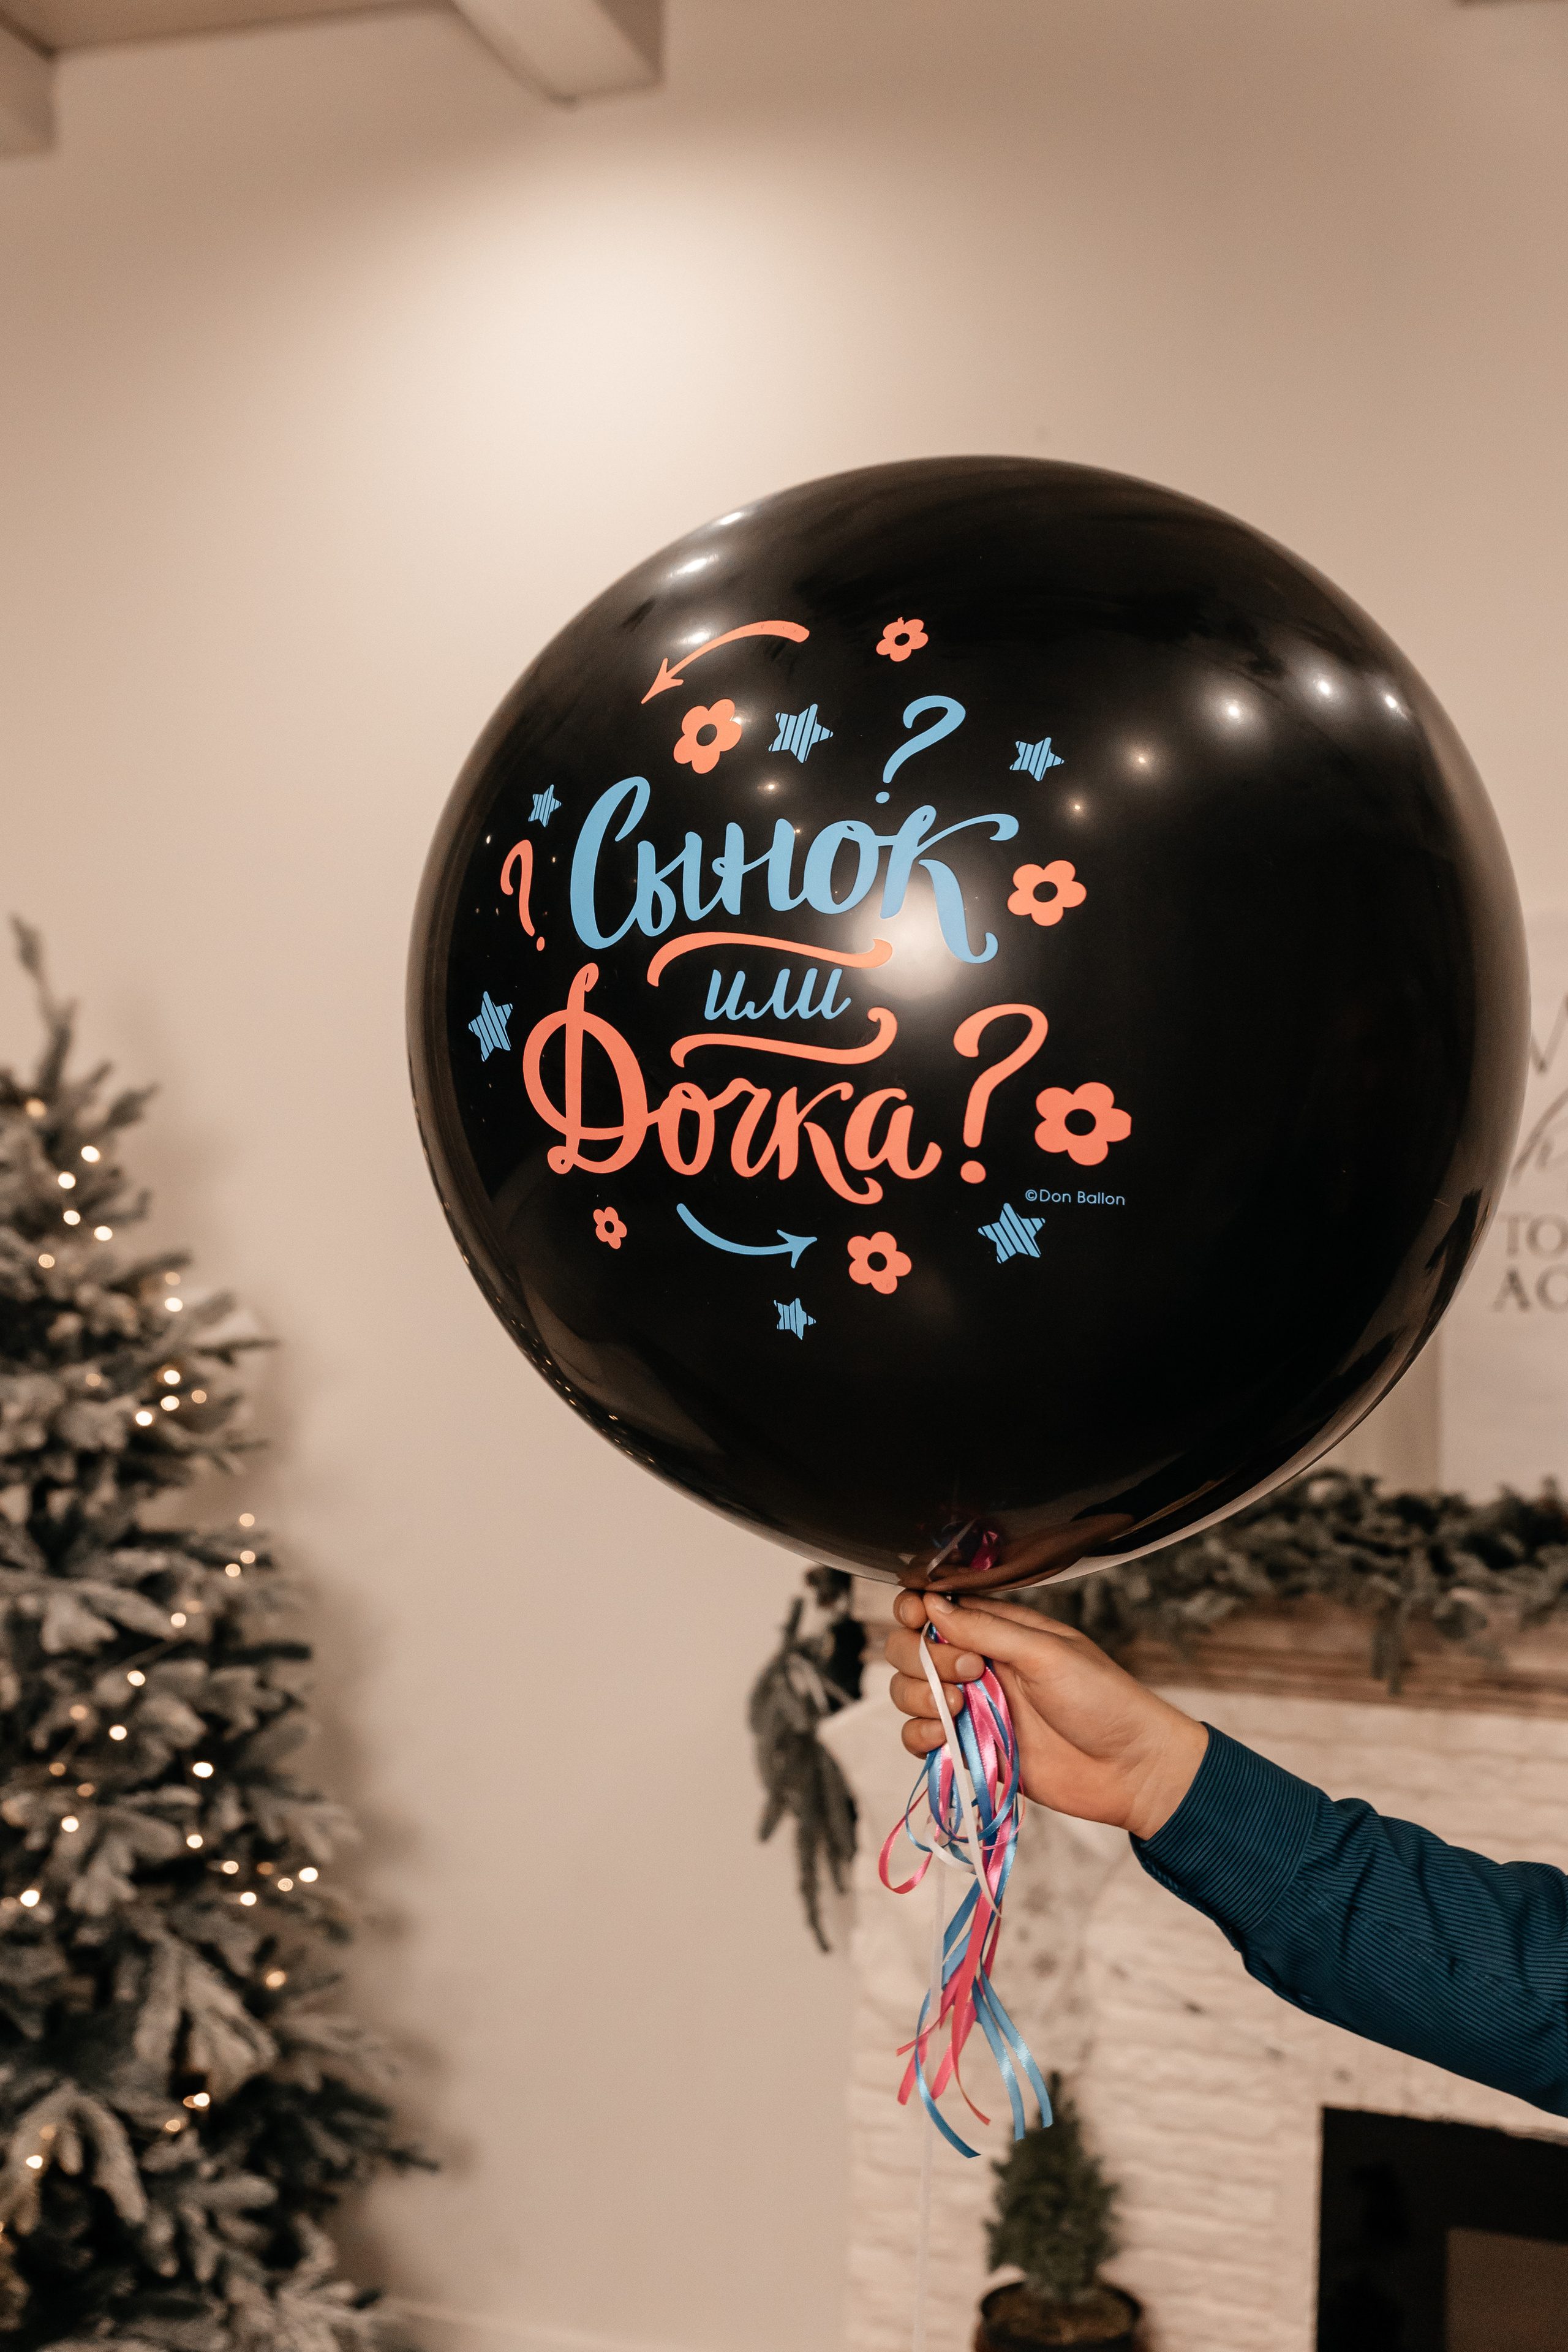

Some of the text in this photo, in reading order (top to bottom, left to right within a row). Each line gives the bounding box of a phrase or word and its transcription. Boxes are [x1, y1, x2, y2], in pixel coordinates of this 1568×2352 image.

[570, 776, 1019, 963] Сынок
[704, 968, 851, 1020] или
[1076, 1190, 1126, 1206] Ballon
